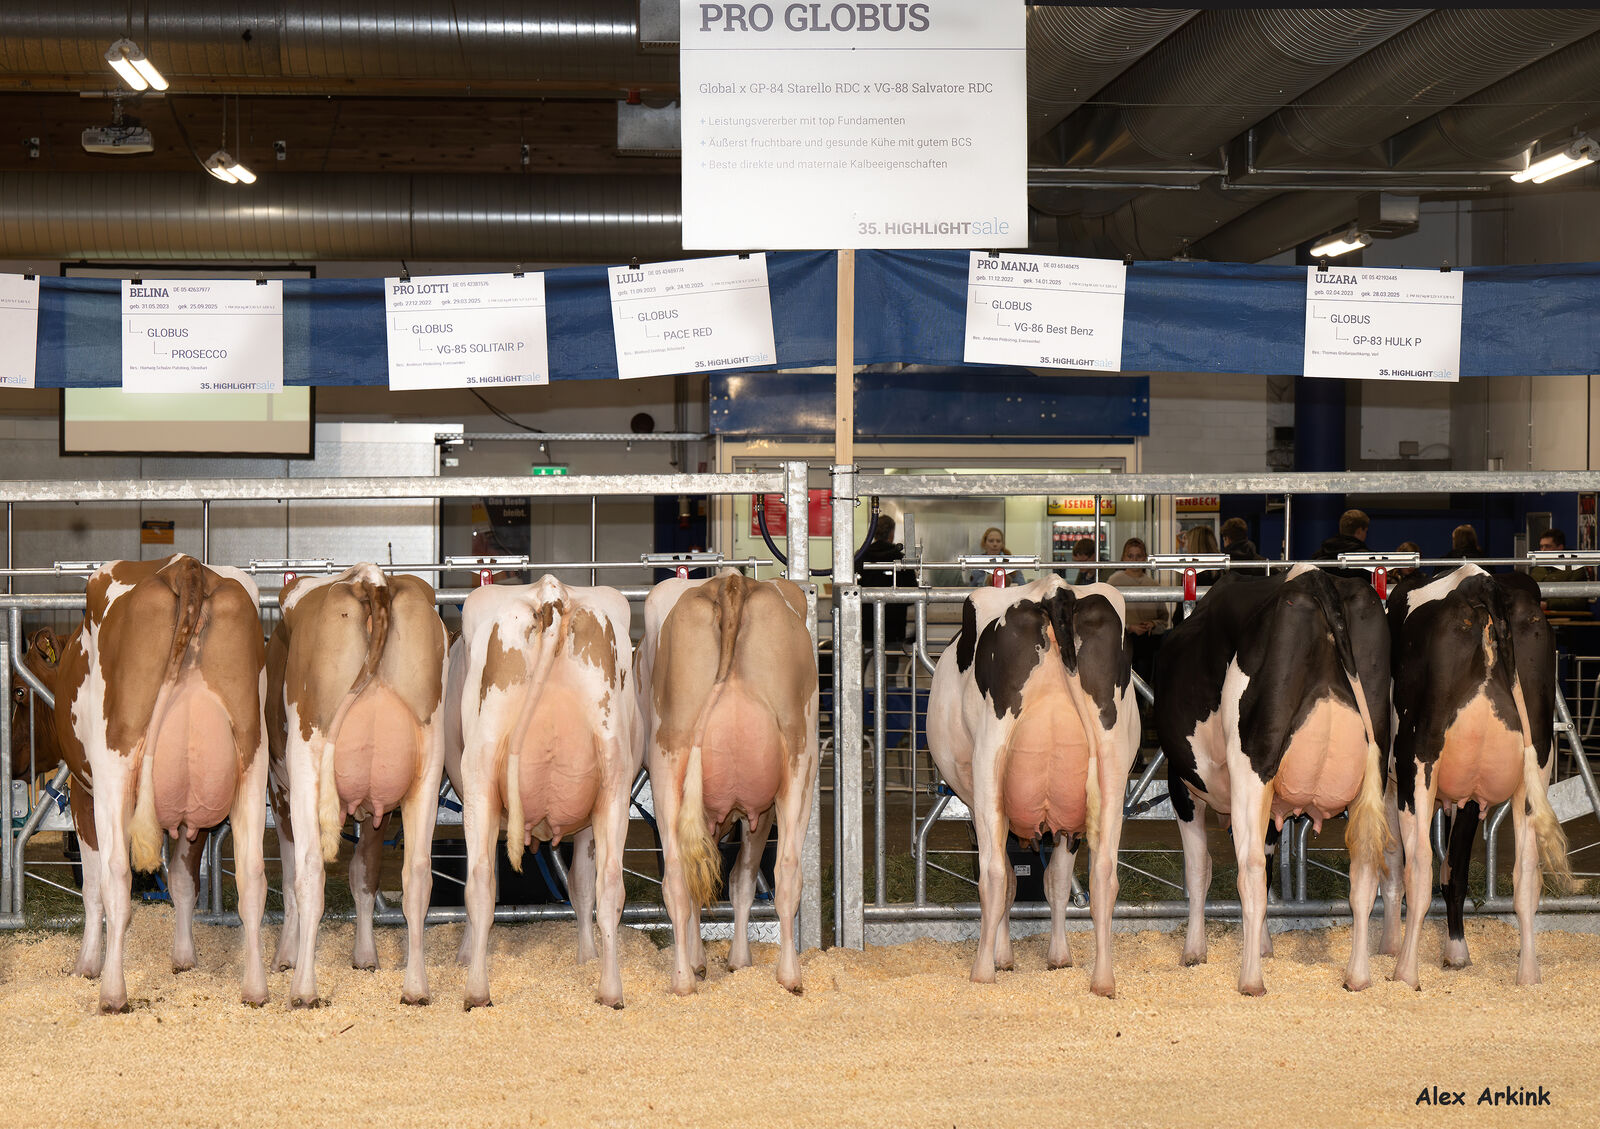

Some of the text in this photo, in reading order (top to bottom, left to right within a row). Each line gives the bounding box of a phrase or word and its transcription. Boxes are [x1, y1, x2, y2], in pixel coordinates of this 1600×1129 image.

[700, 3, 930, 32] PRO GLOBUS
[700, 83, 736, 94] Global
[750, 83, 783, 94] GP-84
[788, 83, 832, 94] Starello
[836, 83, 860, 94] RDC
[874, 83, 908, 94] VG-88
[912, 83, 964, 94] Salvatore
[968, 83, 993, 94] RDC
[708, 116, 797, 128] Leistungsvererber
[800, 116, 816, 125] mit
[818, 117, 835, 127] top
[838, 116, 905, 126] Fundamenten
[709, 136, 748, 147] Äußerst
[750, 137, 802, 147] fruchtbare
[804, 137, 823, 147] und
[826, 137, 868, 149] gesunde
[871, 137, 895, 147] Kühe
[898, 137, 914, 147] mit
[917, 138, 948, 149] gutem
[951, 137, 972, 147] BCS
[709, 159, 738, 169] Beste
[740, 158, 774, 169] direkte
[776, 158, 795, 169] und
[798, 159, 847, 169] maternale
[850, 158, 948, 171] Kalbeeigenschaften
[858, 222, 881, 235] 35.
[977, 260, 998, 270] PRO
[1001, 261, 1039, 272] MANJA
[617, 273, 644, 284] LULU
[1316, 274, 1358, 284] ULZARA
[130, 288, 169, 298] BELINA
[393, 285, 414, 295] PRO
[417, 284, 449, 294] LOTTI
[992, 300, 1032, 311] GLOBUS
[638, 310, 678, 322] GLOBUS
[1330, 314, 1370, 324] GLOBUS
[147, 328, 189, 337] GLOBUS
[412, 324, 453, 334] GLOBUS
[664, 327, 712, 340] PACE RED
[1015, 323, 1094, 336] VG-86 Best Benz
[1353, 336, 1422, 346] GP-83 HULK P
[437, 342, 524, 354] VG-85 SOLITAIR P
[171, 350, 227, 358] PROSECCO
[1064, 498, 1112, 509] ISENBCK
